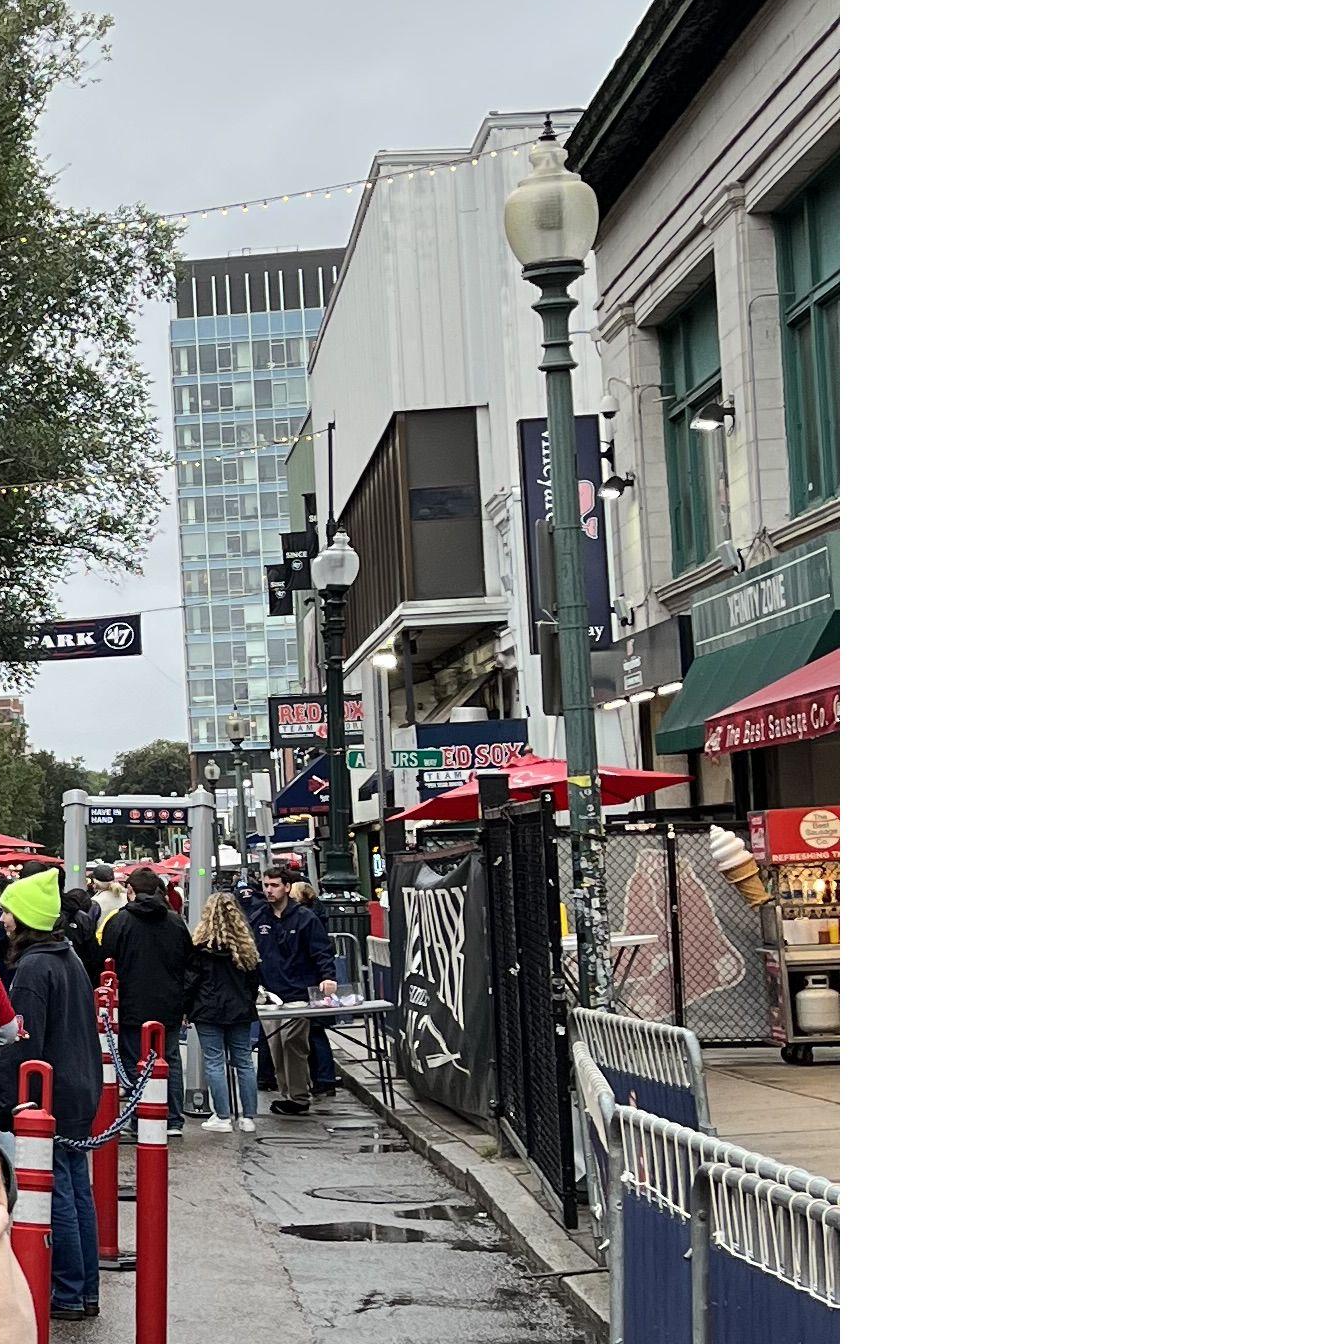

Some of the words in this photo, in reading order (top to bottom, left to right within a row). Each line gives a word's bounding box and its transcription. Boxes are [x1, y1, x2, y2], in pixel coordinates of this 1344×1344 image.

[726, 583, 760, 628] XFINITY
[759, 573, 787, 615] ZONE
[278, 702, 322, 725] RED
[743, 718, 766, 744] Best
[768, 712, 808, 740] Sausage
[810, 702, 829, 730] Co.
[441, 745, 472, 769] ED
[474, 742, 524, 768] SOX
[427, 771, 463, 781] TEAM
[771, 851, 830, 862] REFRESHING
